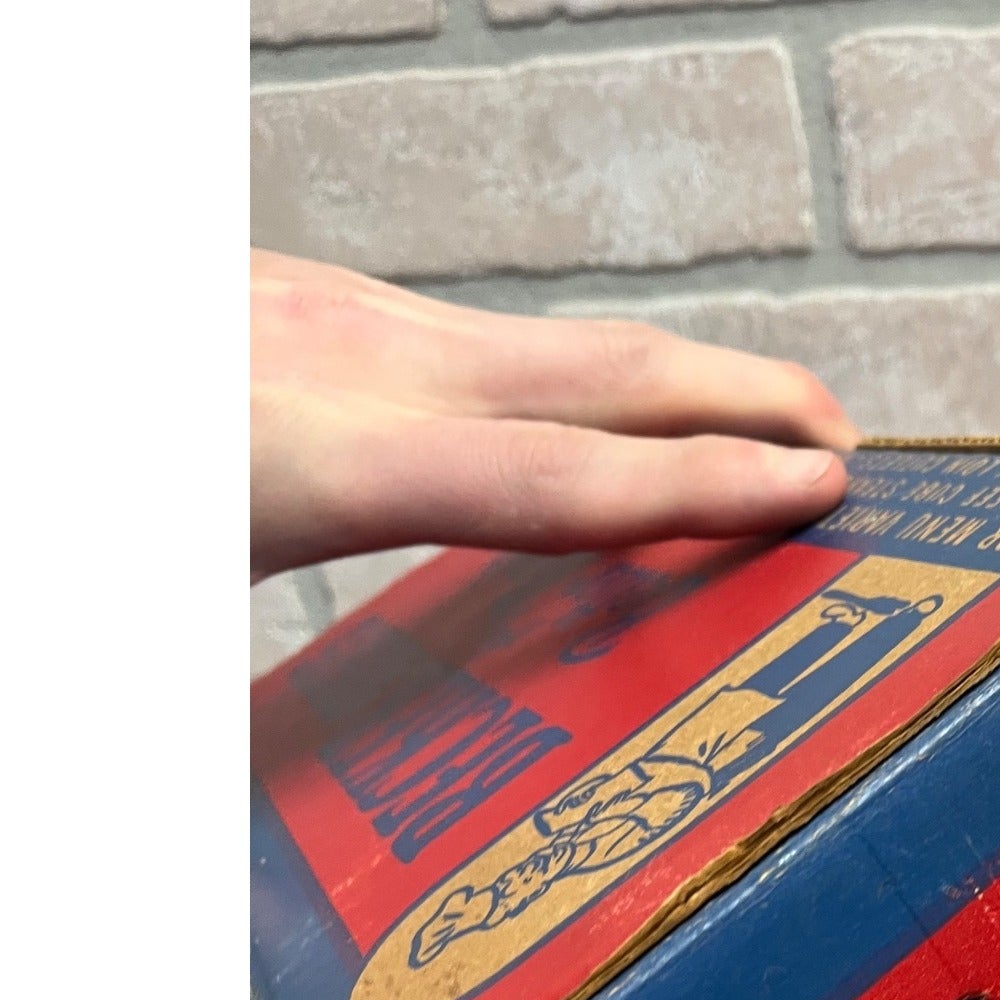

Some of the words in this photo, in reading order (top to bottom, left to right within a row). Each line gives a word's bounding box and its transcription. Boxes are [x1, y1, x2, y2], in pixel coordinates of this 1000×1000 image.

[847, 476, 907, 499] STEA
[902, 480, 965, 505] CUBE
[816, 505, 906, 536] VARIET
[896, 512, 989, 546] MENU
